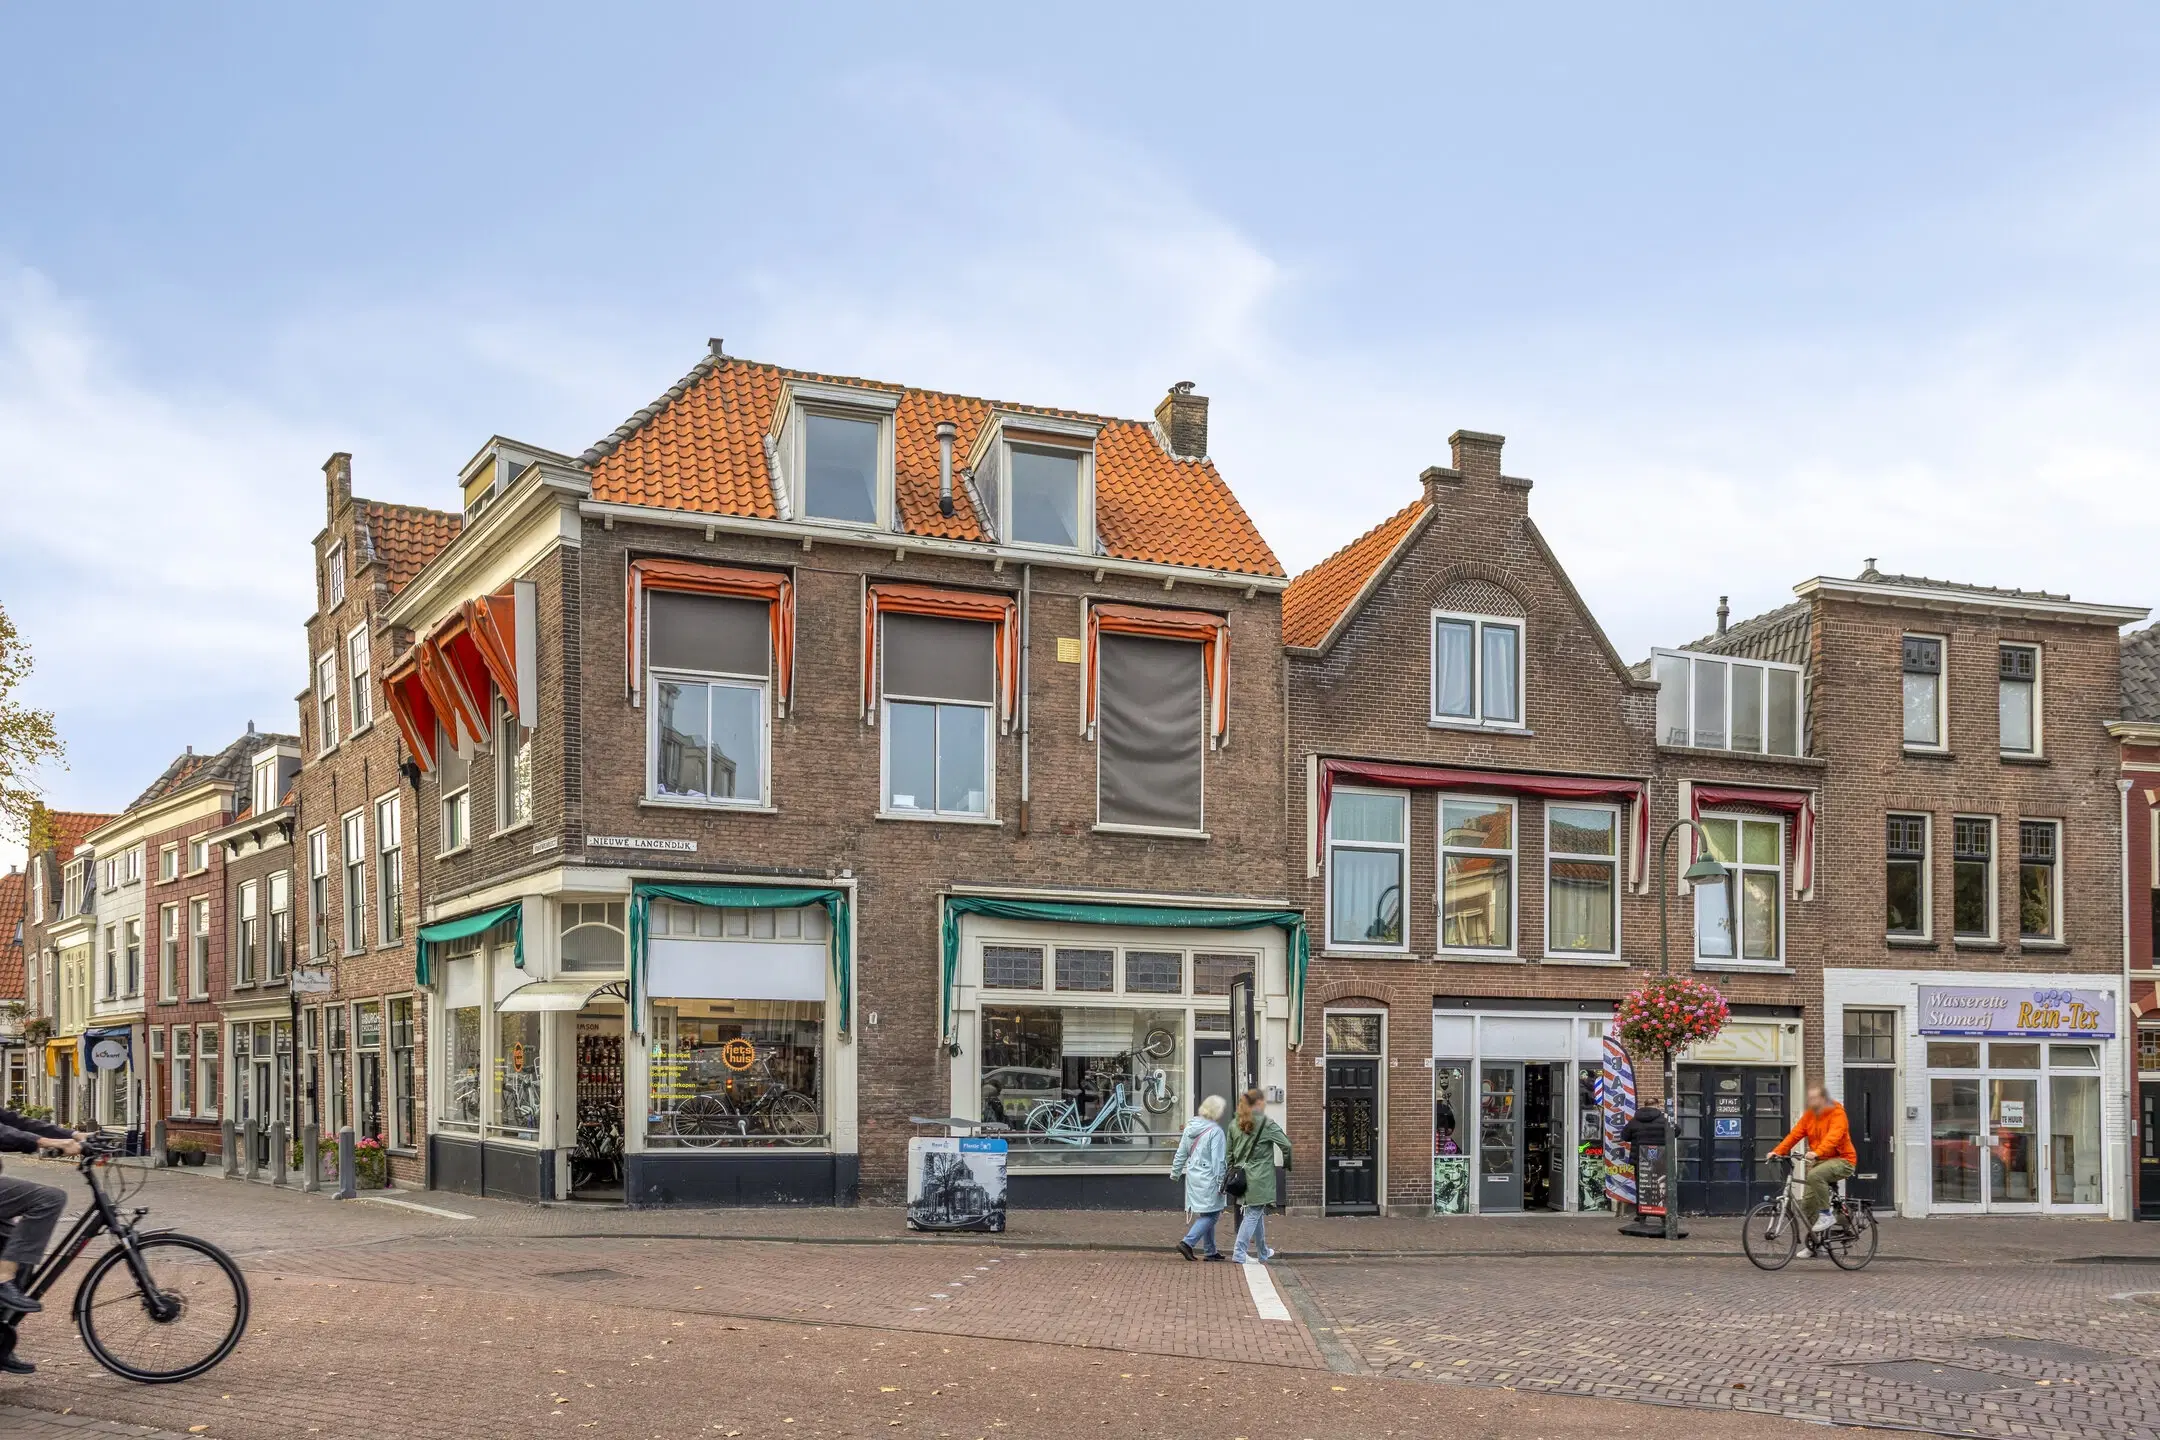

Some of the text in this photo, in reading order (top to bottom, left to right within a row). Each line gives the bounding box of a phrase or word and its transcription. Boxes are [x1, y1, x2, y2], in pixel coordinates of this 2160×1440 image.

[593, 837, 691, 850] NIEUWE LANGENDIJK
[1930, 992, 2008, 1009] Wasserette
[1928, 1010, 1994, 1031] Stomerij
[2017, 1001, 2100, 1030] Rein-Tex
[726, 1044, 752, 1054] fiets
[730, 1053, 752, 1063] huis
[1729, 1119, 1738, 1131] P
